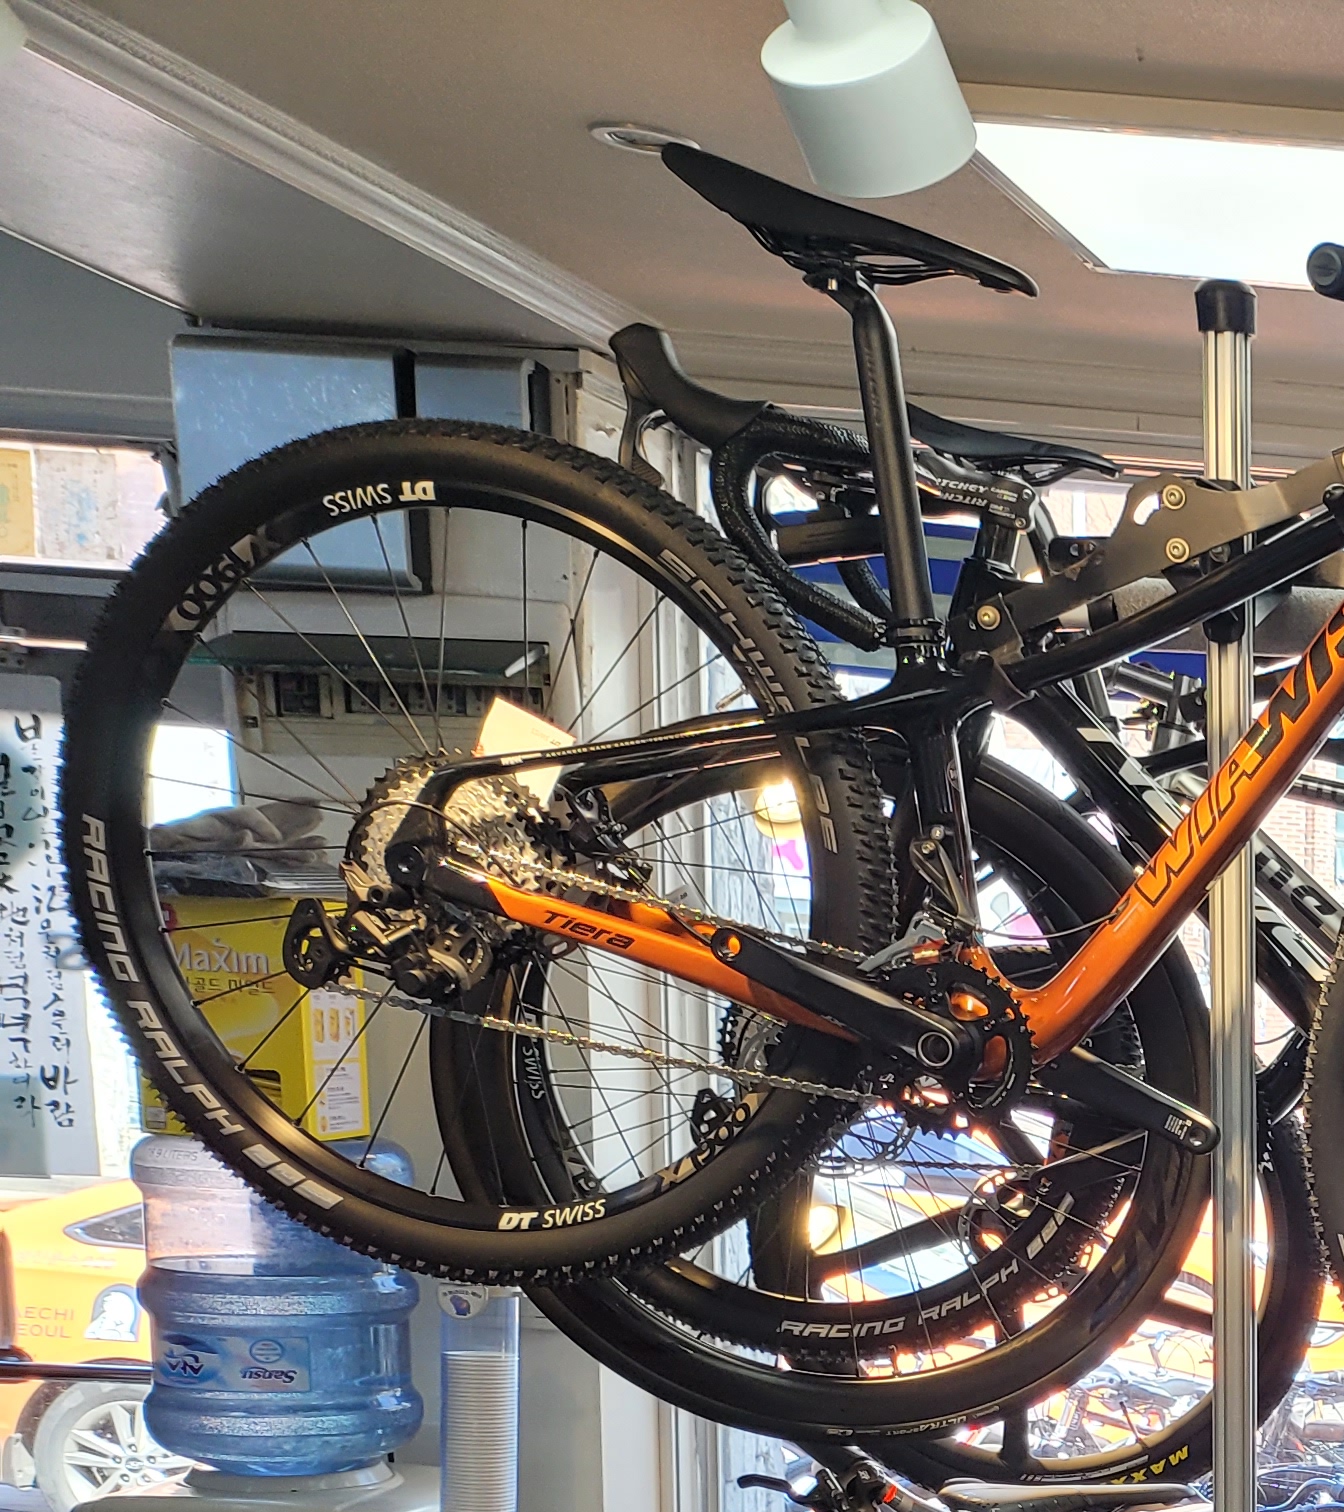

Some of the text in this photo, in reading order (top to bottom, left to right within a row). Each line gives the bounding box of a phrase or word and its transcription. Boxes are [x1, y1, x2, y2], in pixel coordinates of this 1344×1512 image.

[321, 480, 436, 517] DT SWISS
[542, 909, 636, 951] Tiera
[81, 812, 246, 1137] RACING RALPH
[498, 1198, 607, 1232] DT SWISS
[780, 1259, 1021, 1339] RACING RALPH
[17, 1323, 72, 1338] EOUL
[240, 1366, 298, 1384] Sansu
